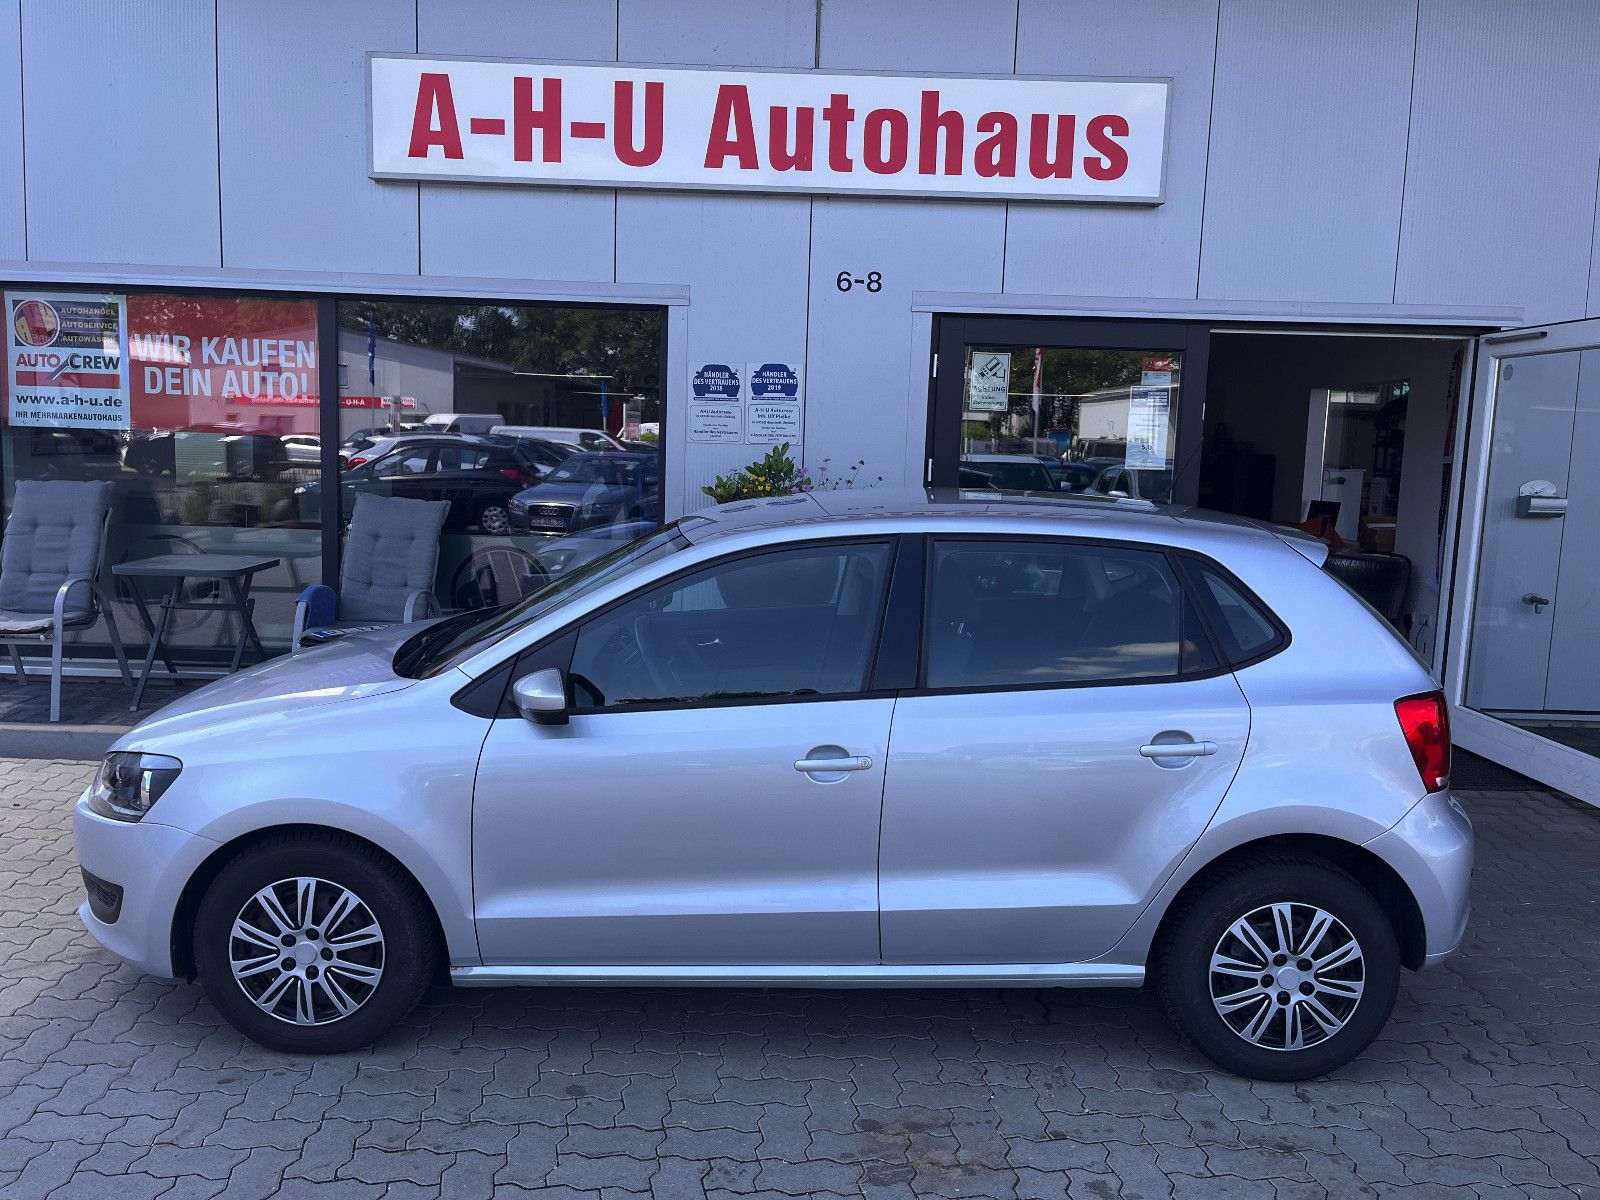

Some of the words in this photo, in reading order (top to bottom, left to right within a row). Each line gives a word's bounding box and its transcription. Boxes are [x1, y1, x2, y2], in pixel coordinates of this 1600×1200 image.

[408, 72, 664, 167] A-H-U
[703, 84, 1129, 181] Autohaus
[836, 270, 883, 293] 6-8
[60, 307, 116, 316] AUTOHANDEL
[61, 321, 118, 330] AUTOSERVICE
[134, 332, 192, 363] WIR
[201, 335, 315, 369] KAUFEN
[703, 371, 730, 379] HÄNDLER
[144, 366, 211, 396] DEIN
[221, 368, 308, 401] AUTO!
[705, 378, 739, 386] VERTRAUENS
[16, 395, 123, 408] www.a-h-u.de
[30, 411, 123, 422] MEHRMARKENAUTOHAUS
